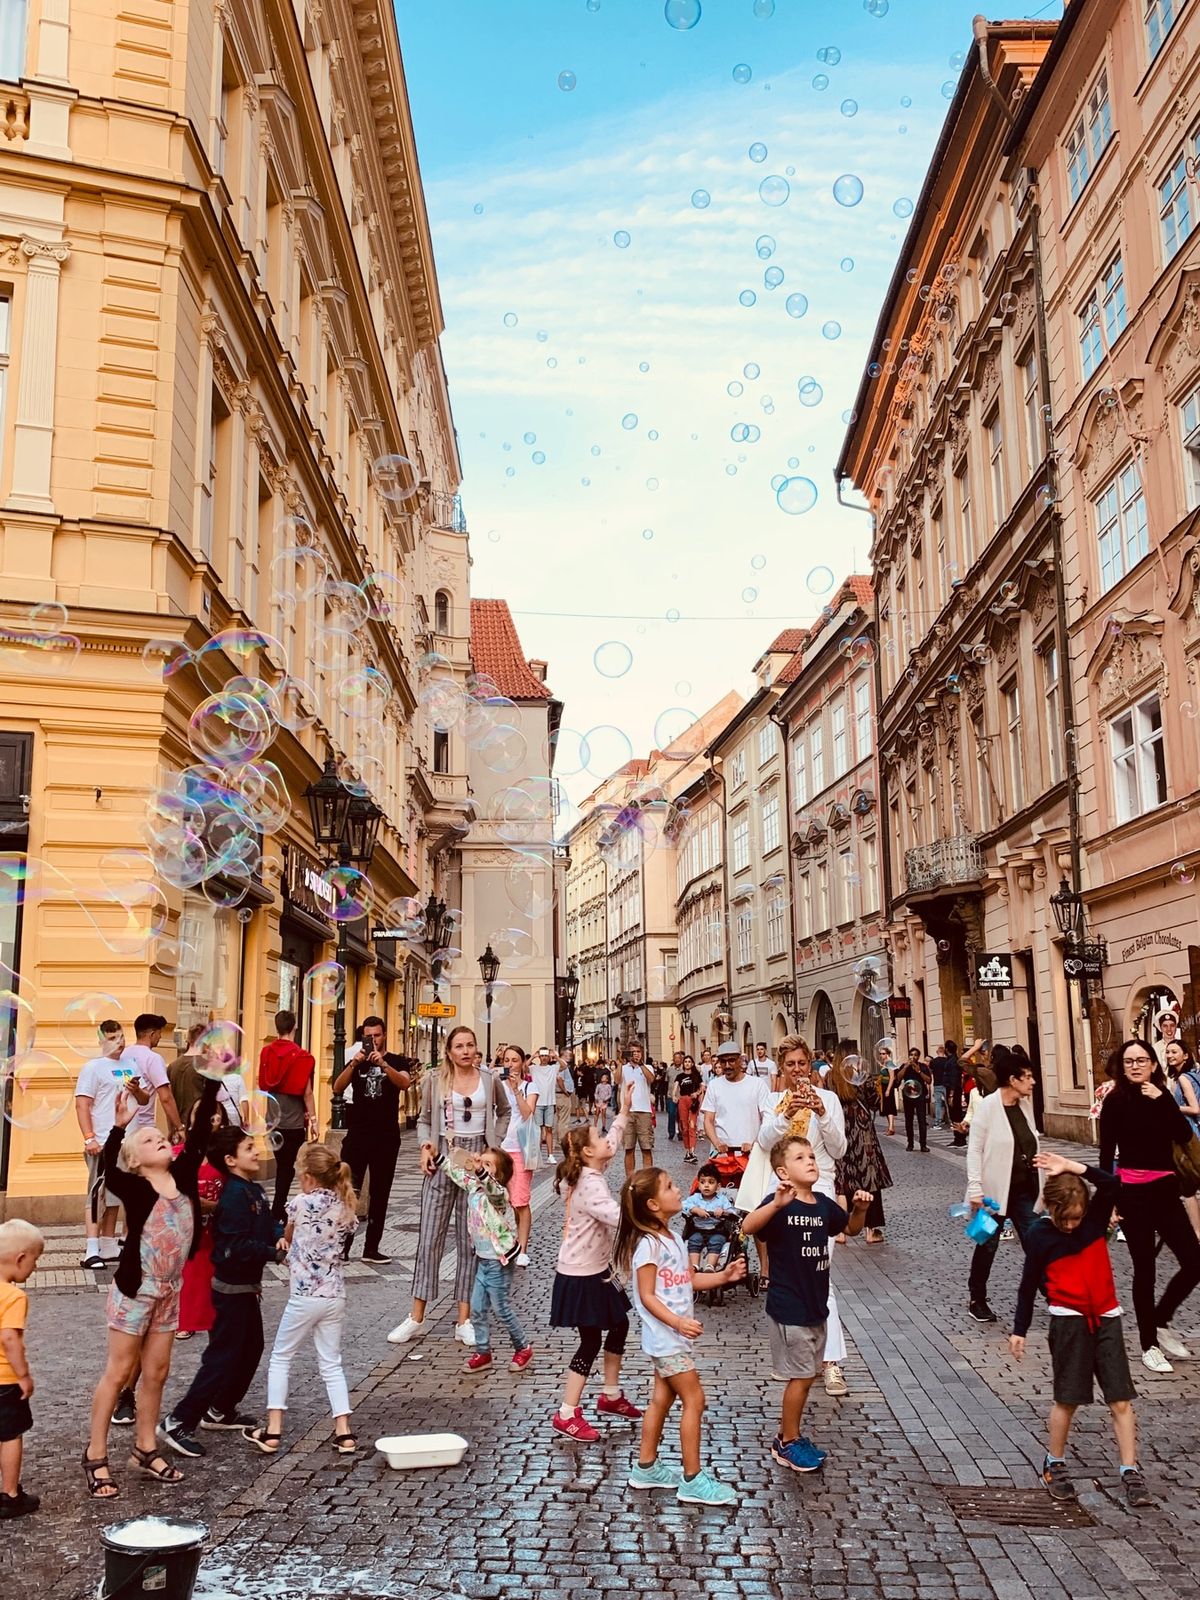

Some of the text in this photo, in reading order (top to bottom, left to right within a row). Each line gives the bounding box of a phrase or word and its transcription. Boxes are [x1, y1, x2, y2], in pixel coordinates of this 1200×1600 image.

[1136, 935, 1153, 950] Belgian
[1155, 931, 1181, 950] Chocolates
[787, 1215, 824, 1227] KEEPING
[803, 1231, 812, 1241] IT
[801, 1246, 820, 1257] COOL
